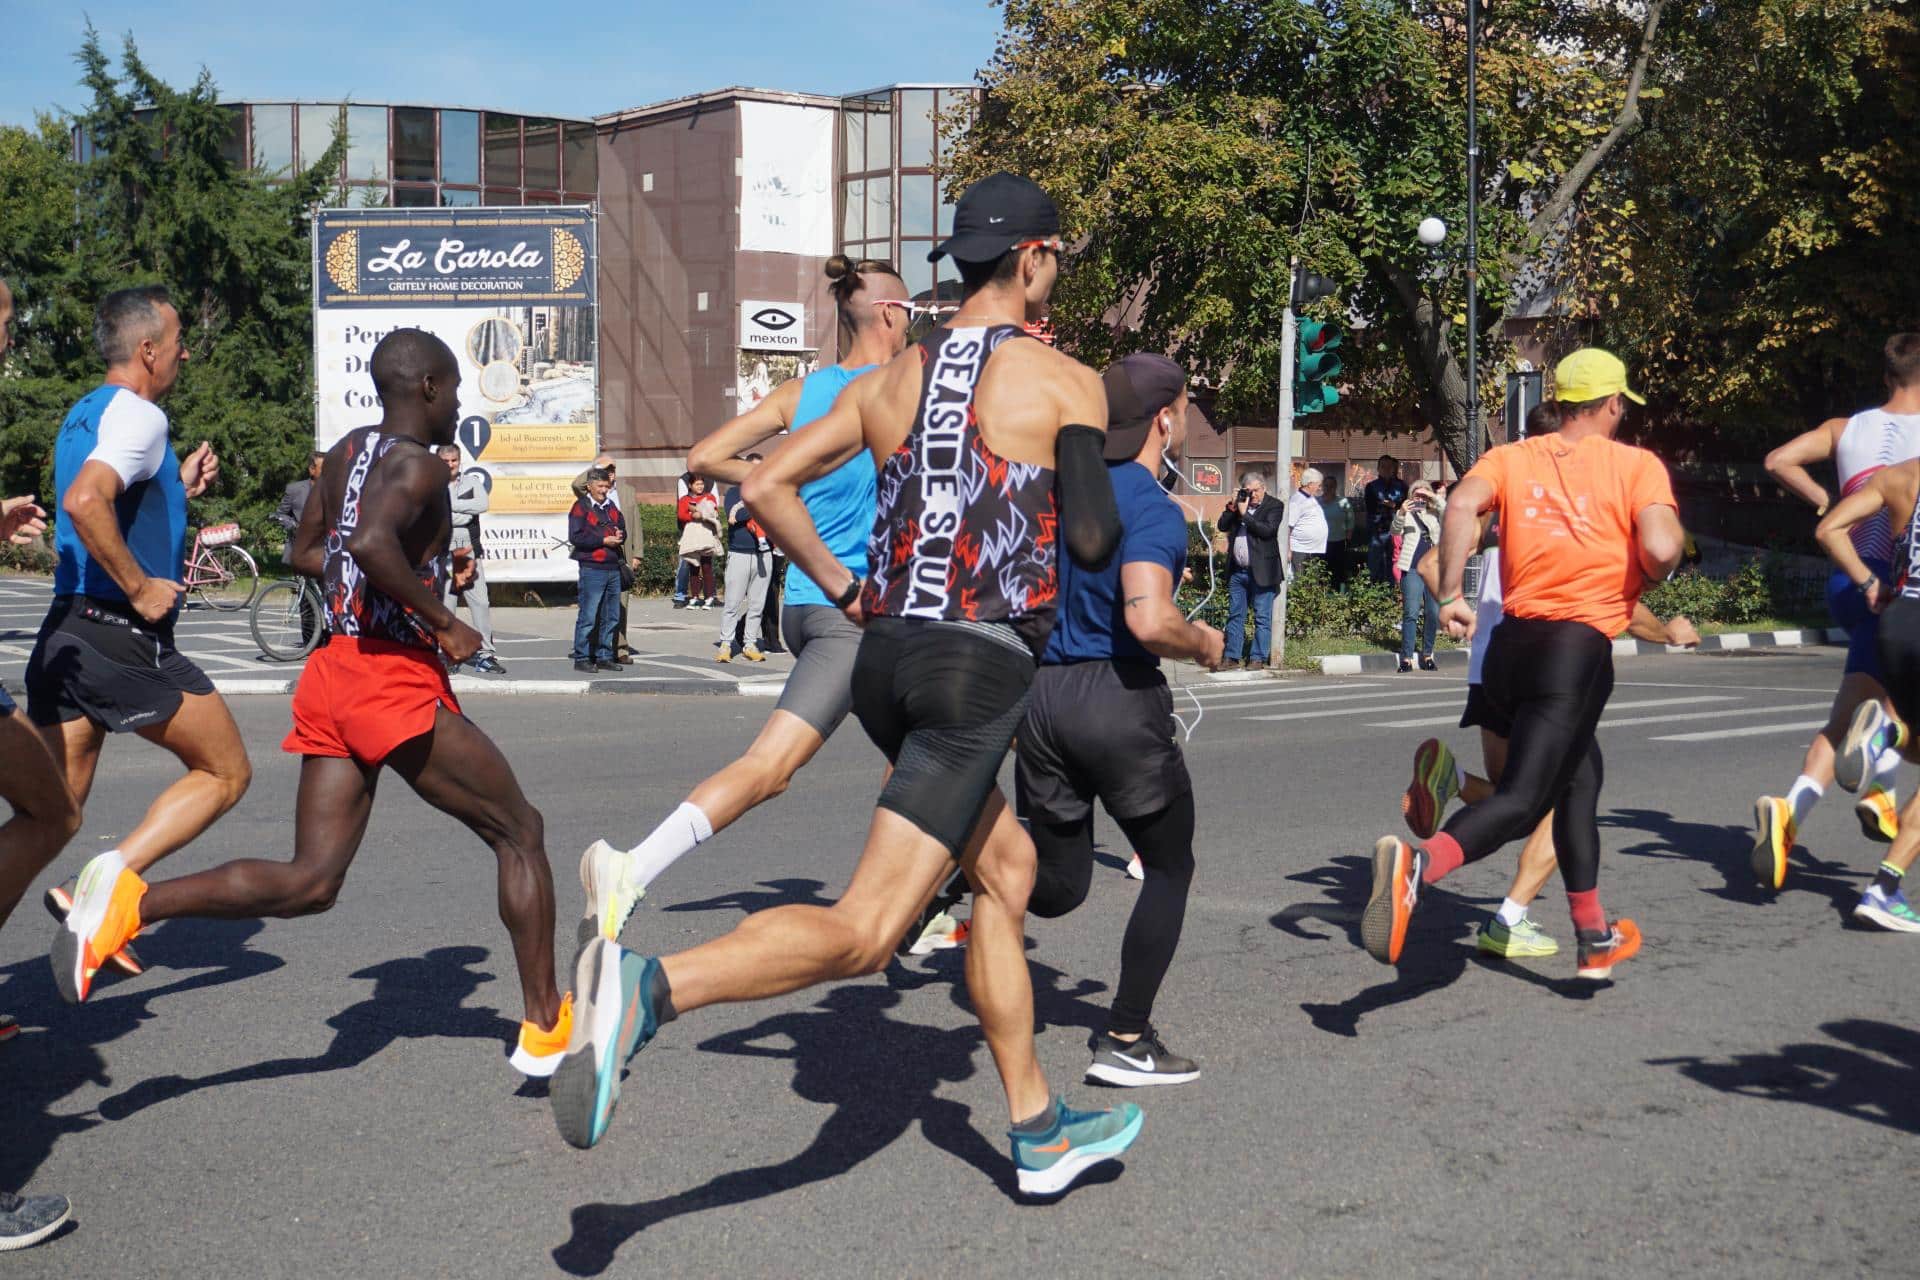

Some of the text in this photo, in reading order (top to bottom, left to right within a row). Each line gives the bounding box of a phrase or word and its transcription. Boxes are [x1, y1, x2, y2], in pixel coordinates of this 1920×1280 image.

[367, 238, 543, 274] La Carola
[388, 280, 524, 292] GRITELY HOME DECORATION
[750, 334, 798, 344] mexton
[923, 338, 982, 499] SEASIDE
[470, 420, 480, 447] 1
[484, 529, 547, 539] ANOPERA
